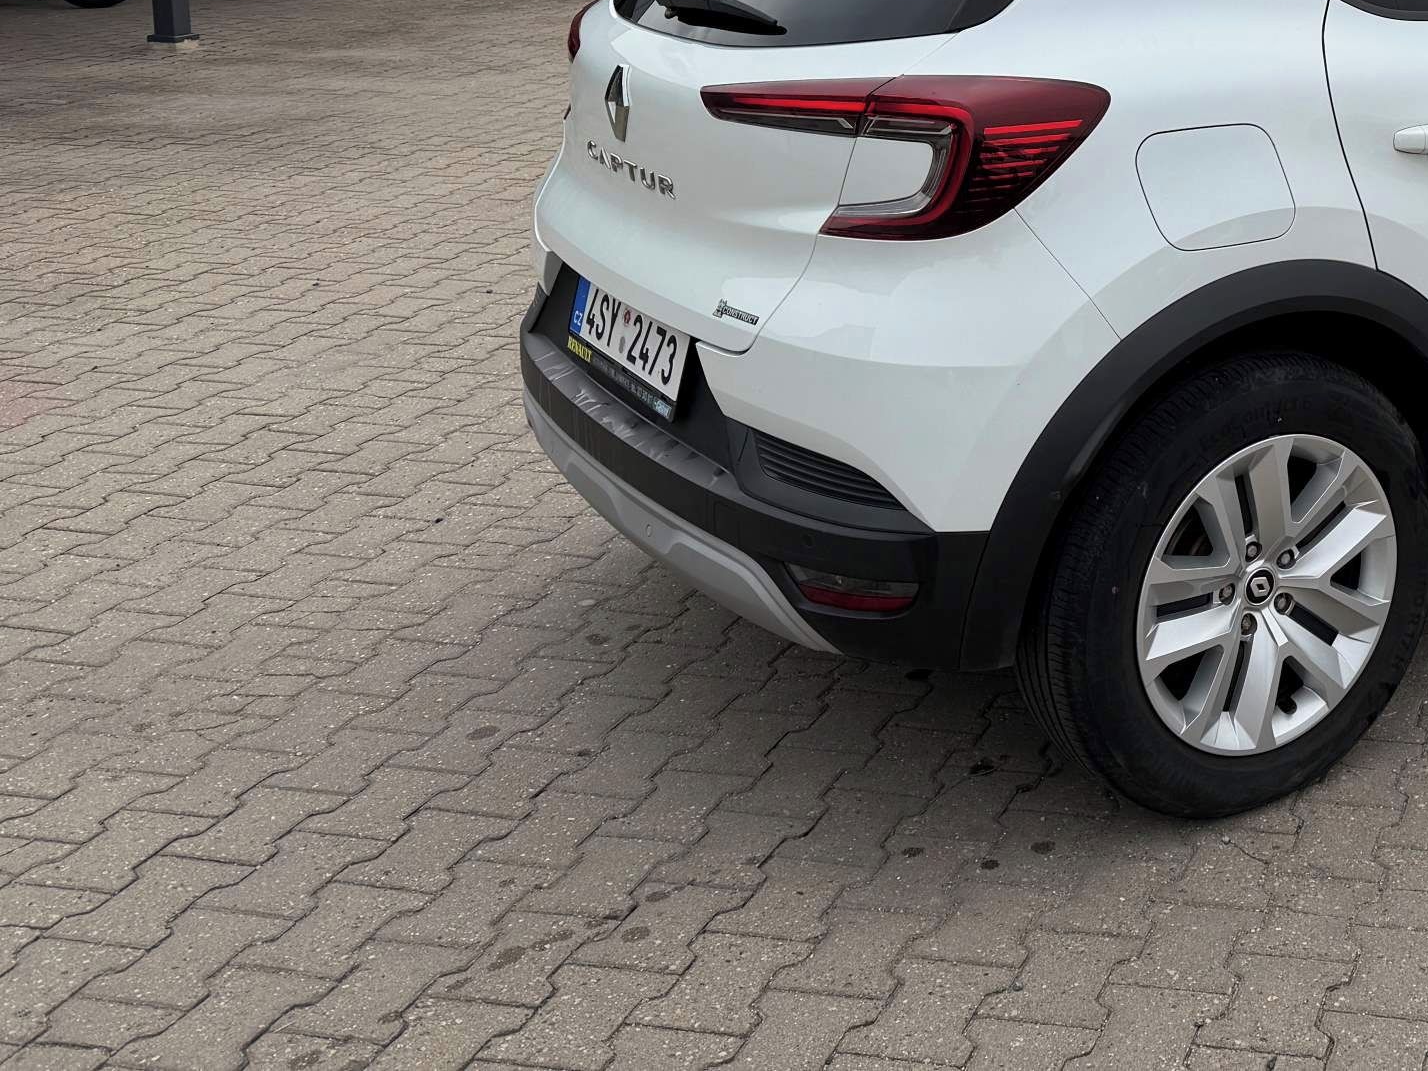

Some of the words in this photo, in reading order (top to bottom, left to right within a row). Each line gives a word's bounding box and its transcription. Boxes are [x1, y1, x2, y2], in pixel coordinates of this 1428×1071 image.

[586, 139, 677, 201] CAPTUR
[573, 310, 583, 326] CZ
[722, 305, 760, 326] CONSTRUCT
[567, 335, 593, 363] RENAULT
[586, 288, 622, 348] 4SY
[626, 314, 678, 386] 2473
